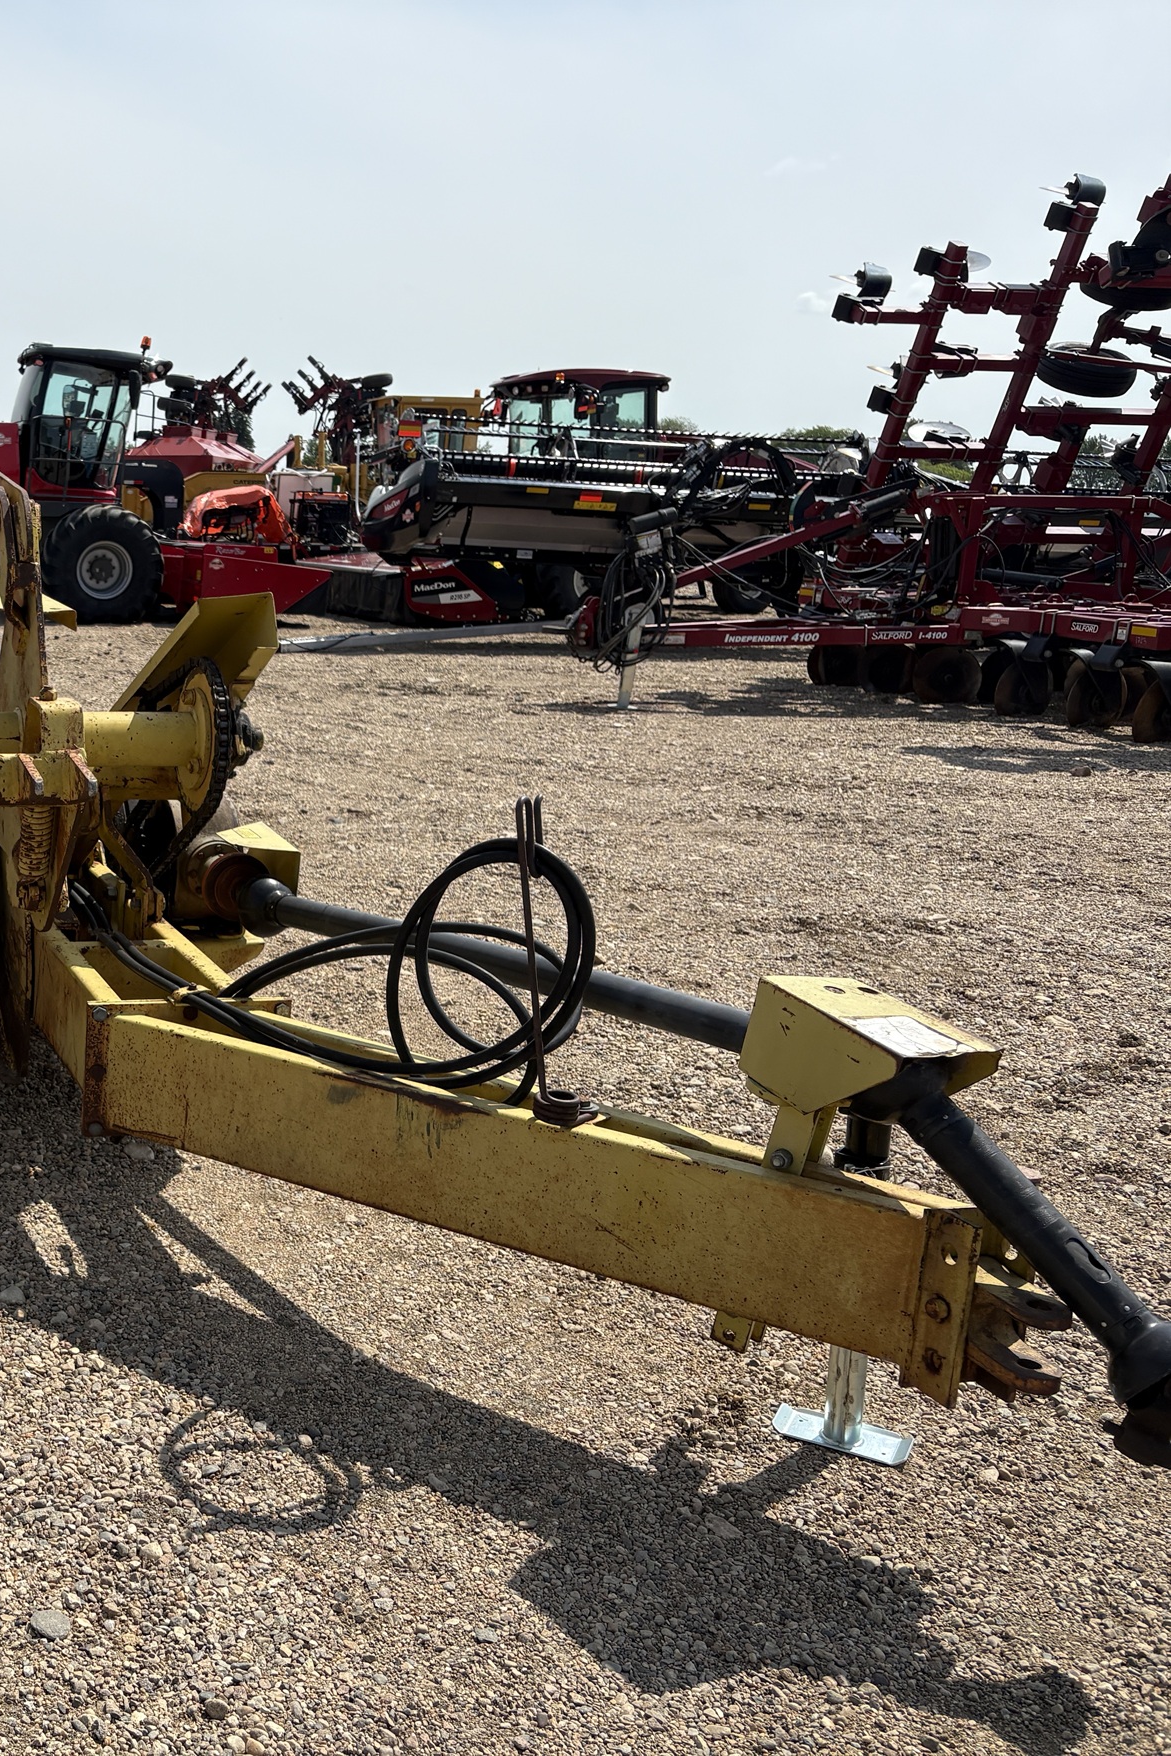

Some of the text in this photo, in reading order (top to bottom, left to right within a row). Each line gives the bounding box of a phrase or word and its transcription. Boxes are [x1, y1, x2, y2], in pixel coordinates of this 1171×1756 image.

[414, 581, 456, 593] MacDon
[1070, 621, 1099, 634] SALFORD
[724, 632, 820, 643] INDEPENDENT 4100
[871, 630, 948, 641] SALFORD I-4100
